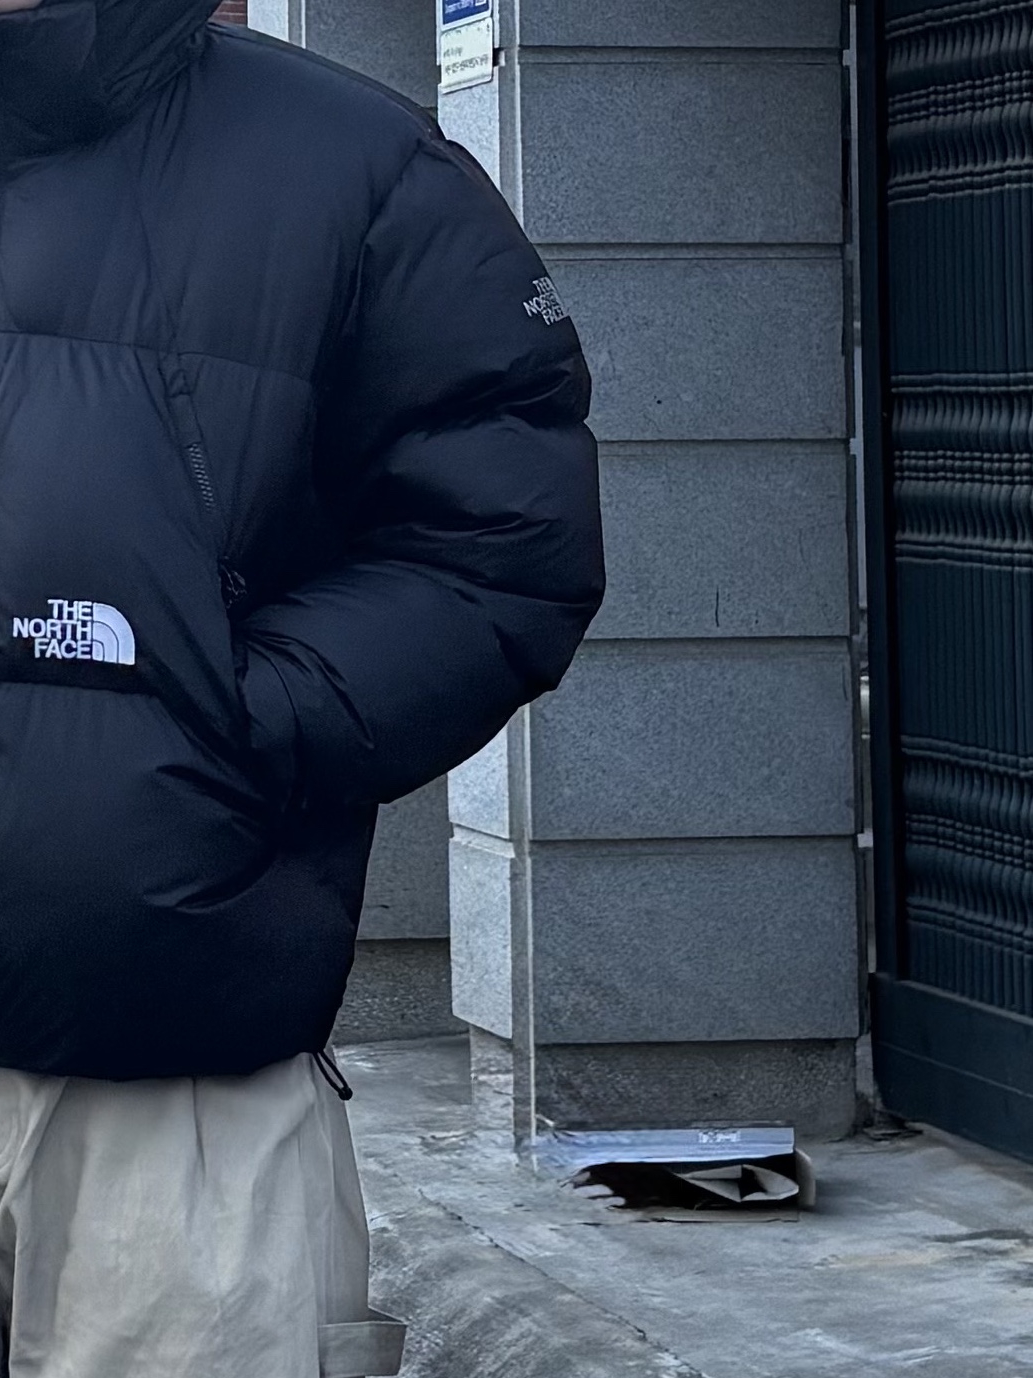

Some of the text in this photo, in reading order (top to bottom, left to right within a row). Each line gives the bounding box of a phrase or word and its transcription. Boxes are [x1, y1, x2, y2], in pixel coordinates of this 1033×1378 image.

[47, 599, 92, 621] THE
[12, 617, 92, 641] NORTH
[34, 638, 92, 660] FACE
